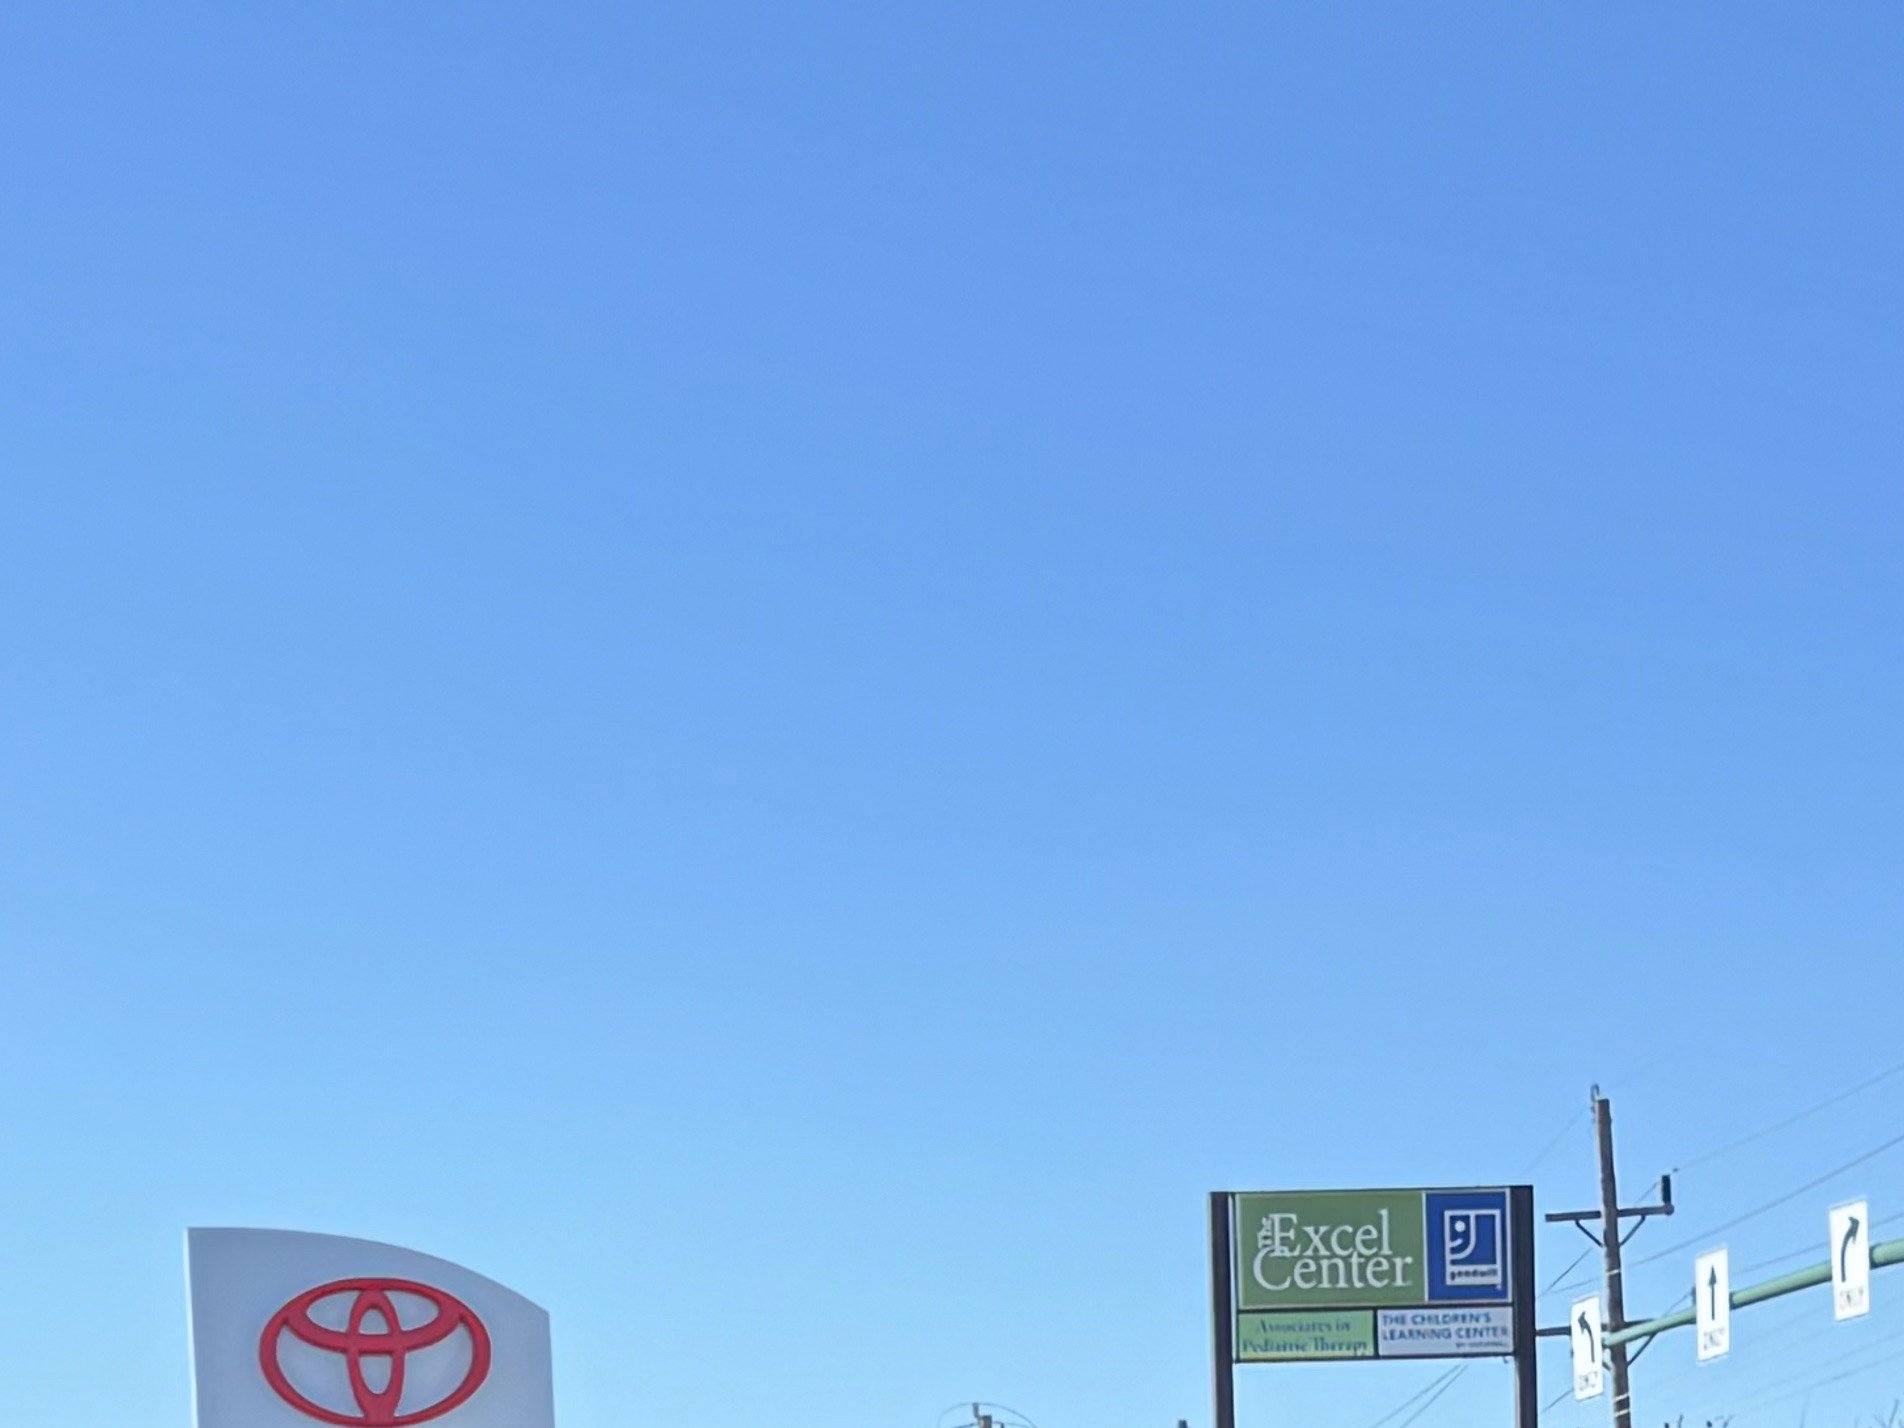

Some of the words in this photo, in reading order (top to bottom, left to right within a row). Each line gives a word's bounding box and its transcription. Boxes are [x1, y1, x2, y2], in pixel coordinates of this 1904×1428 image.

[1267, 1208, 1394, 1257] Excel
[1252, 1248, 1415, 1291] Center
[1411, 1312, 1492, 1325] CHILDREN'S
[1382, 1328, 1452, 1341] LEARNING
[1456, 1326, 1508, 1340] CENTER
